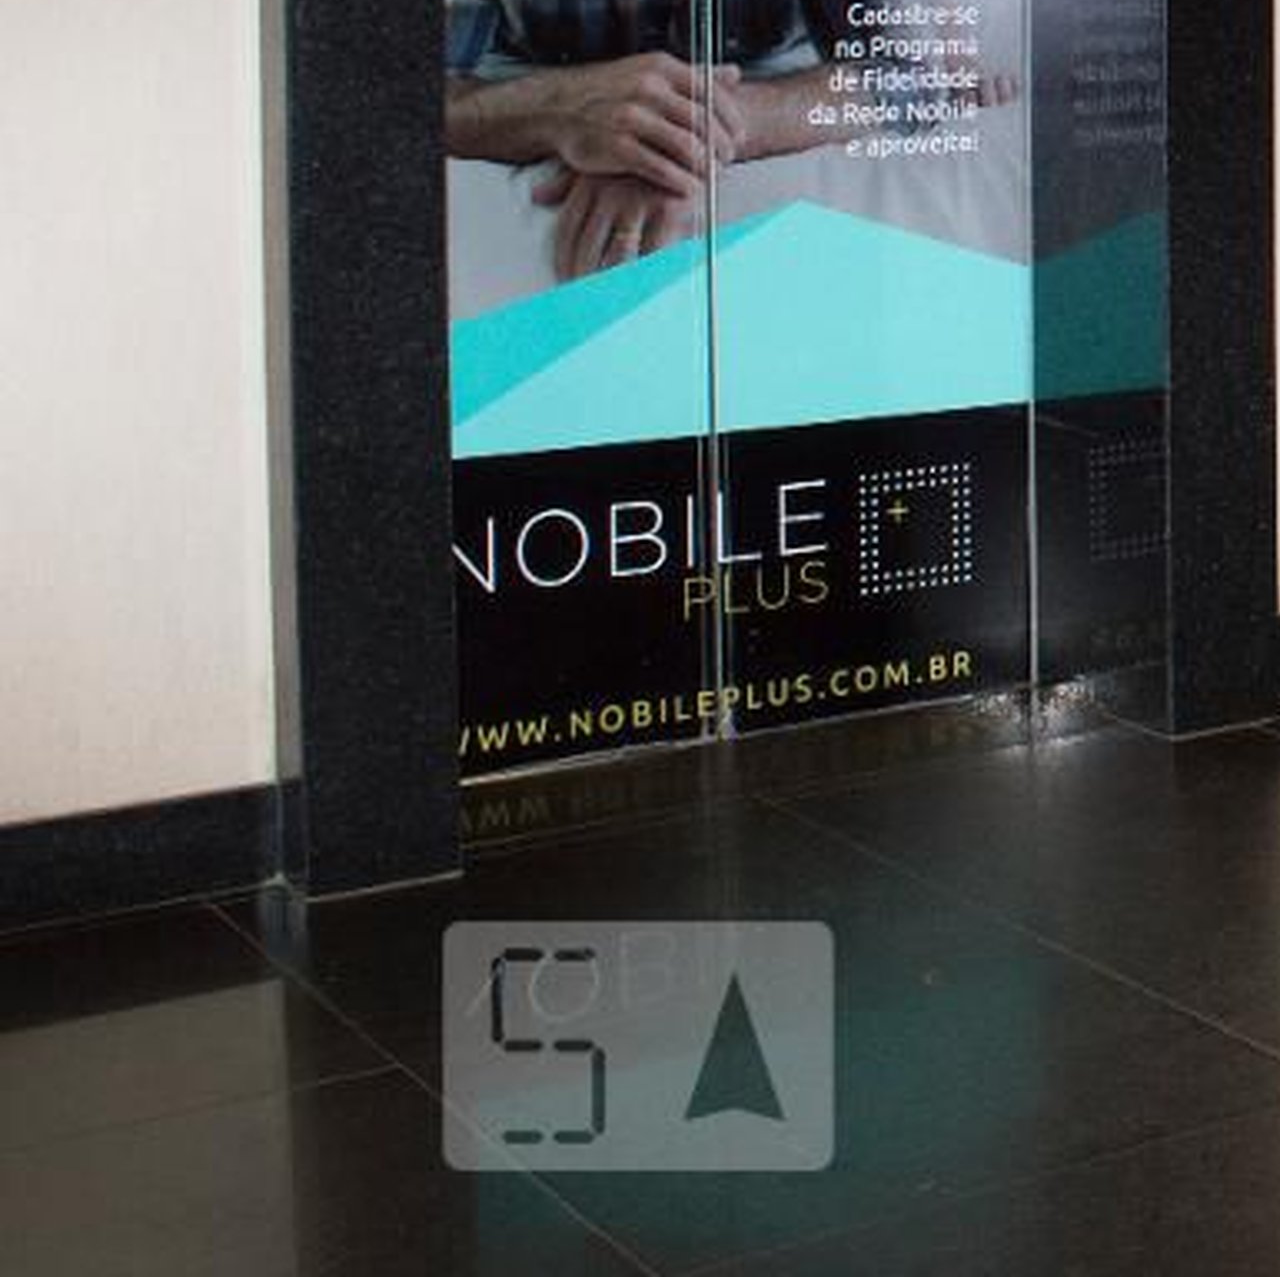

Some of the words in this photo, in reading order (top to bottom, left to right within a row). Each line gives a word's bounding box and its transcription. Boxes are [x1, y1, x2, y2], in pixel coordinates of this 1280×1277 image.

[835, 39, 866, 59] no
[870, 36, 978, 61] Programa
[829, 70, 859, 92] de
[863, 66, 979, 92] Fidelidade
[807, 103, 837, 125] da
[843, 99, 900, 124] Rede
[905, 99, 978, 123] Nobile
[846, 139, 862, 157] e
[682, 560, 830, 622] PLUS
[458, 650, 974, 756] WW.NOBILEPLUS.COM.BR
